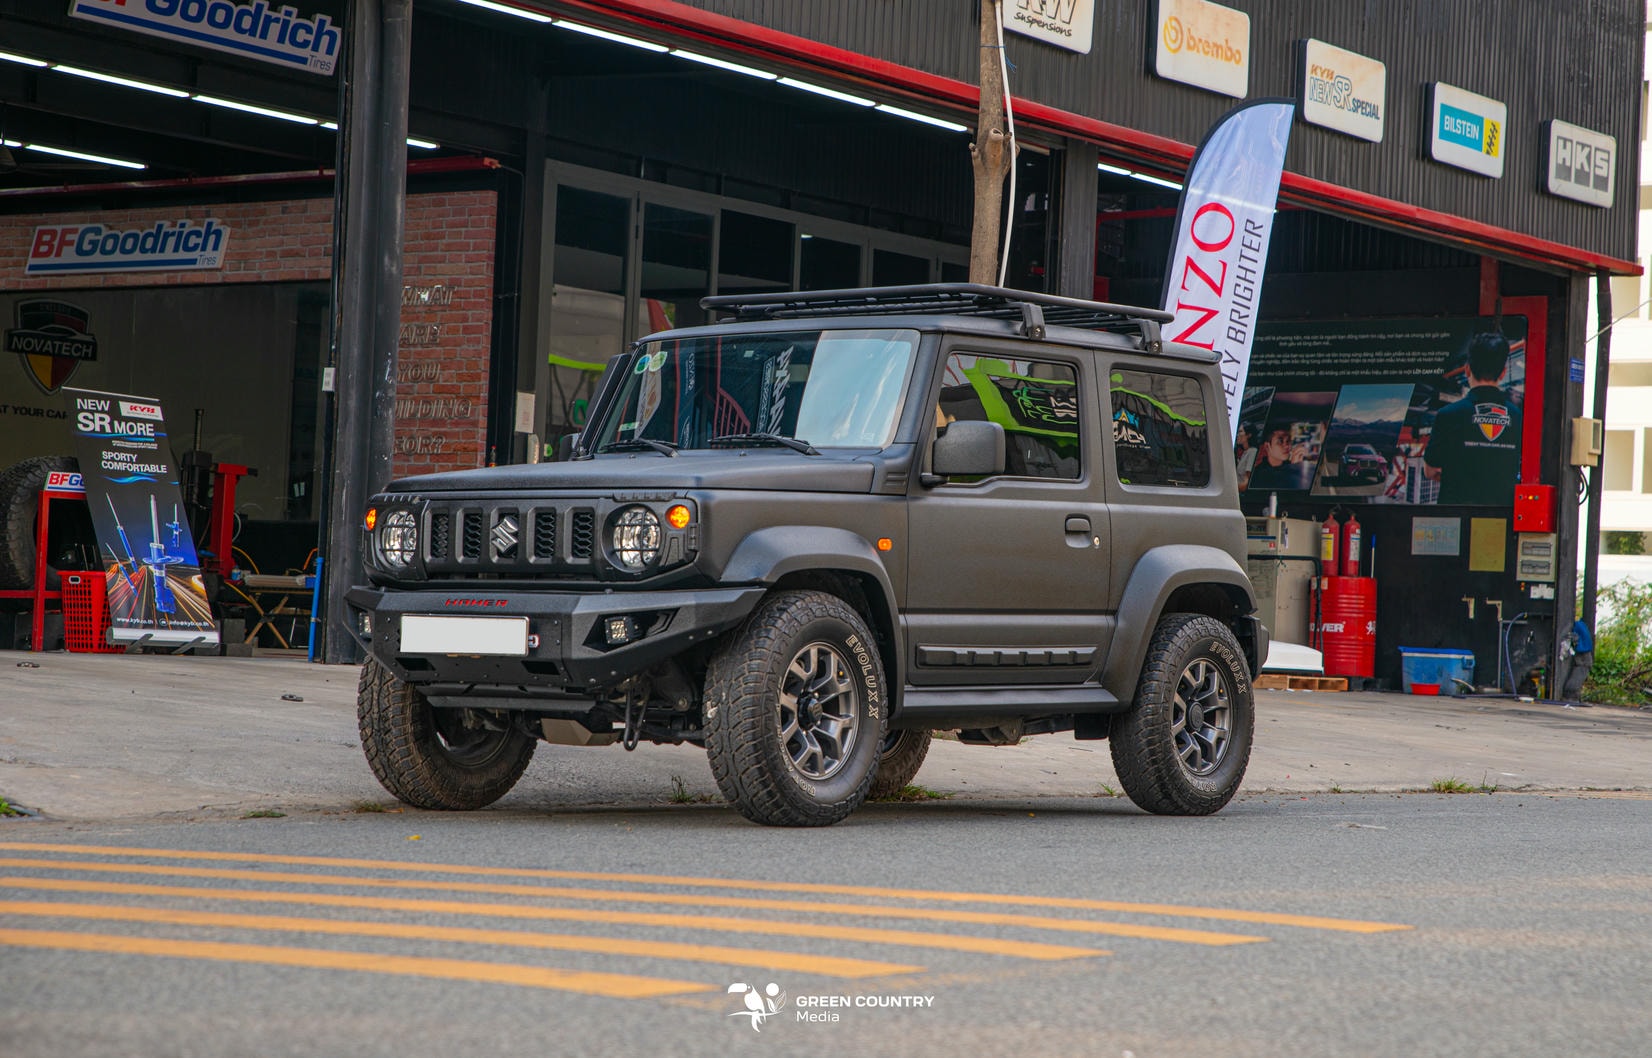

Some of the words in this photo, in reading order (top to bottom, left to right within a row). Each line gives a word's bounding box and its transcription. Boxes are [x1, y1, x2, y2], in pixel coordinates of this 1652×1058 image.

[1013, 12, 1073, 37] suspensions
[1186, 28, 1242, 65] brembo
[309, 54, 332, 71] Tires
[1309, 76, 1335, 107] NEW
[1334, 75, 1353, 112] SR
[1352, 97, 1380, 121] SPECIAL
[1444, 115, 1480, 141] BILSTEIN
[1556, 138, 1611, 178] HKS
[31, 221, 224, 259] BFGoodrich
[198, 254, 217, 266] Tires
[1226, 218, 1264, 345] BRIGHTER
[400, 324, 441, 344] ARE
[11, 336, 94, 358] NOVATECH
[398, 362, 441, 383] YOU
[12, 406, 44, 417] YOUR
[77, 399, 110, 411] NEW
[129, 405, 156, 414] KYB
[77, 412, 111, 433] SR
[113, 420, 154, 436] MORE
[1473, 417, 1510, 425] NOVATECH
[101, 461, 167, 473] COMFORTABLE
[102, 451, 137, 463] SPORTY
[845, 634, 879, 719] EVOLUXX
[1209, 641, 1247, 694] EVOLUXX
